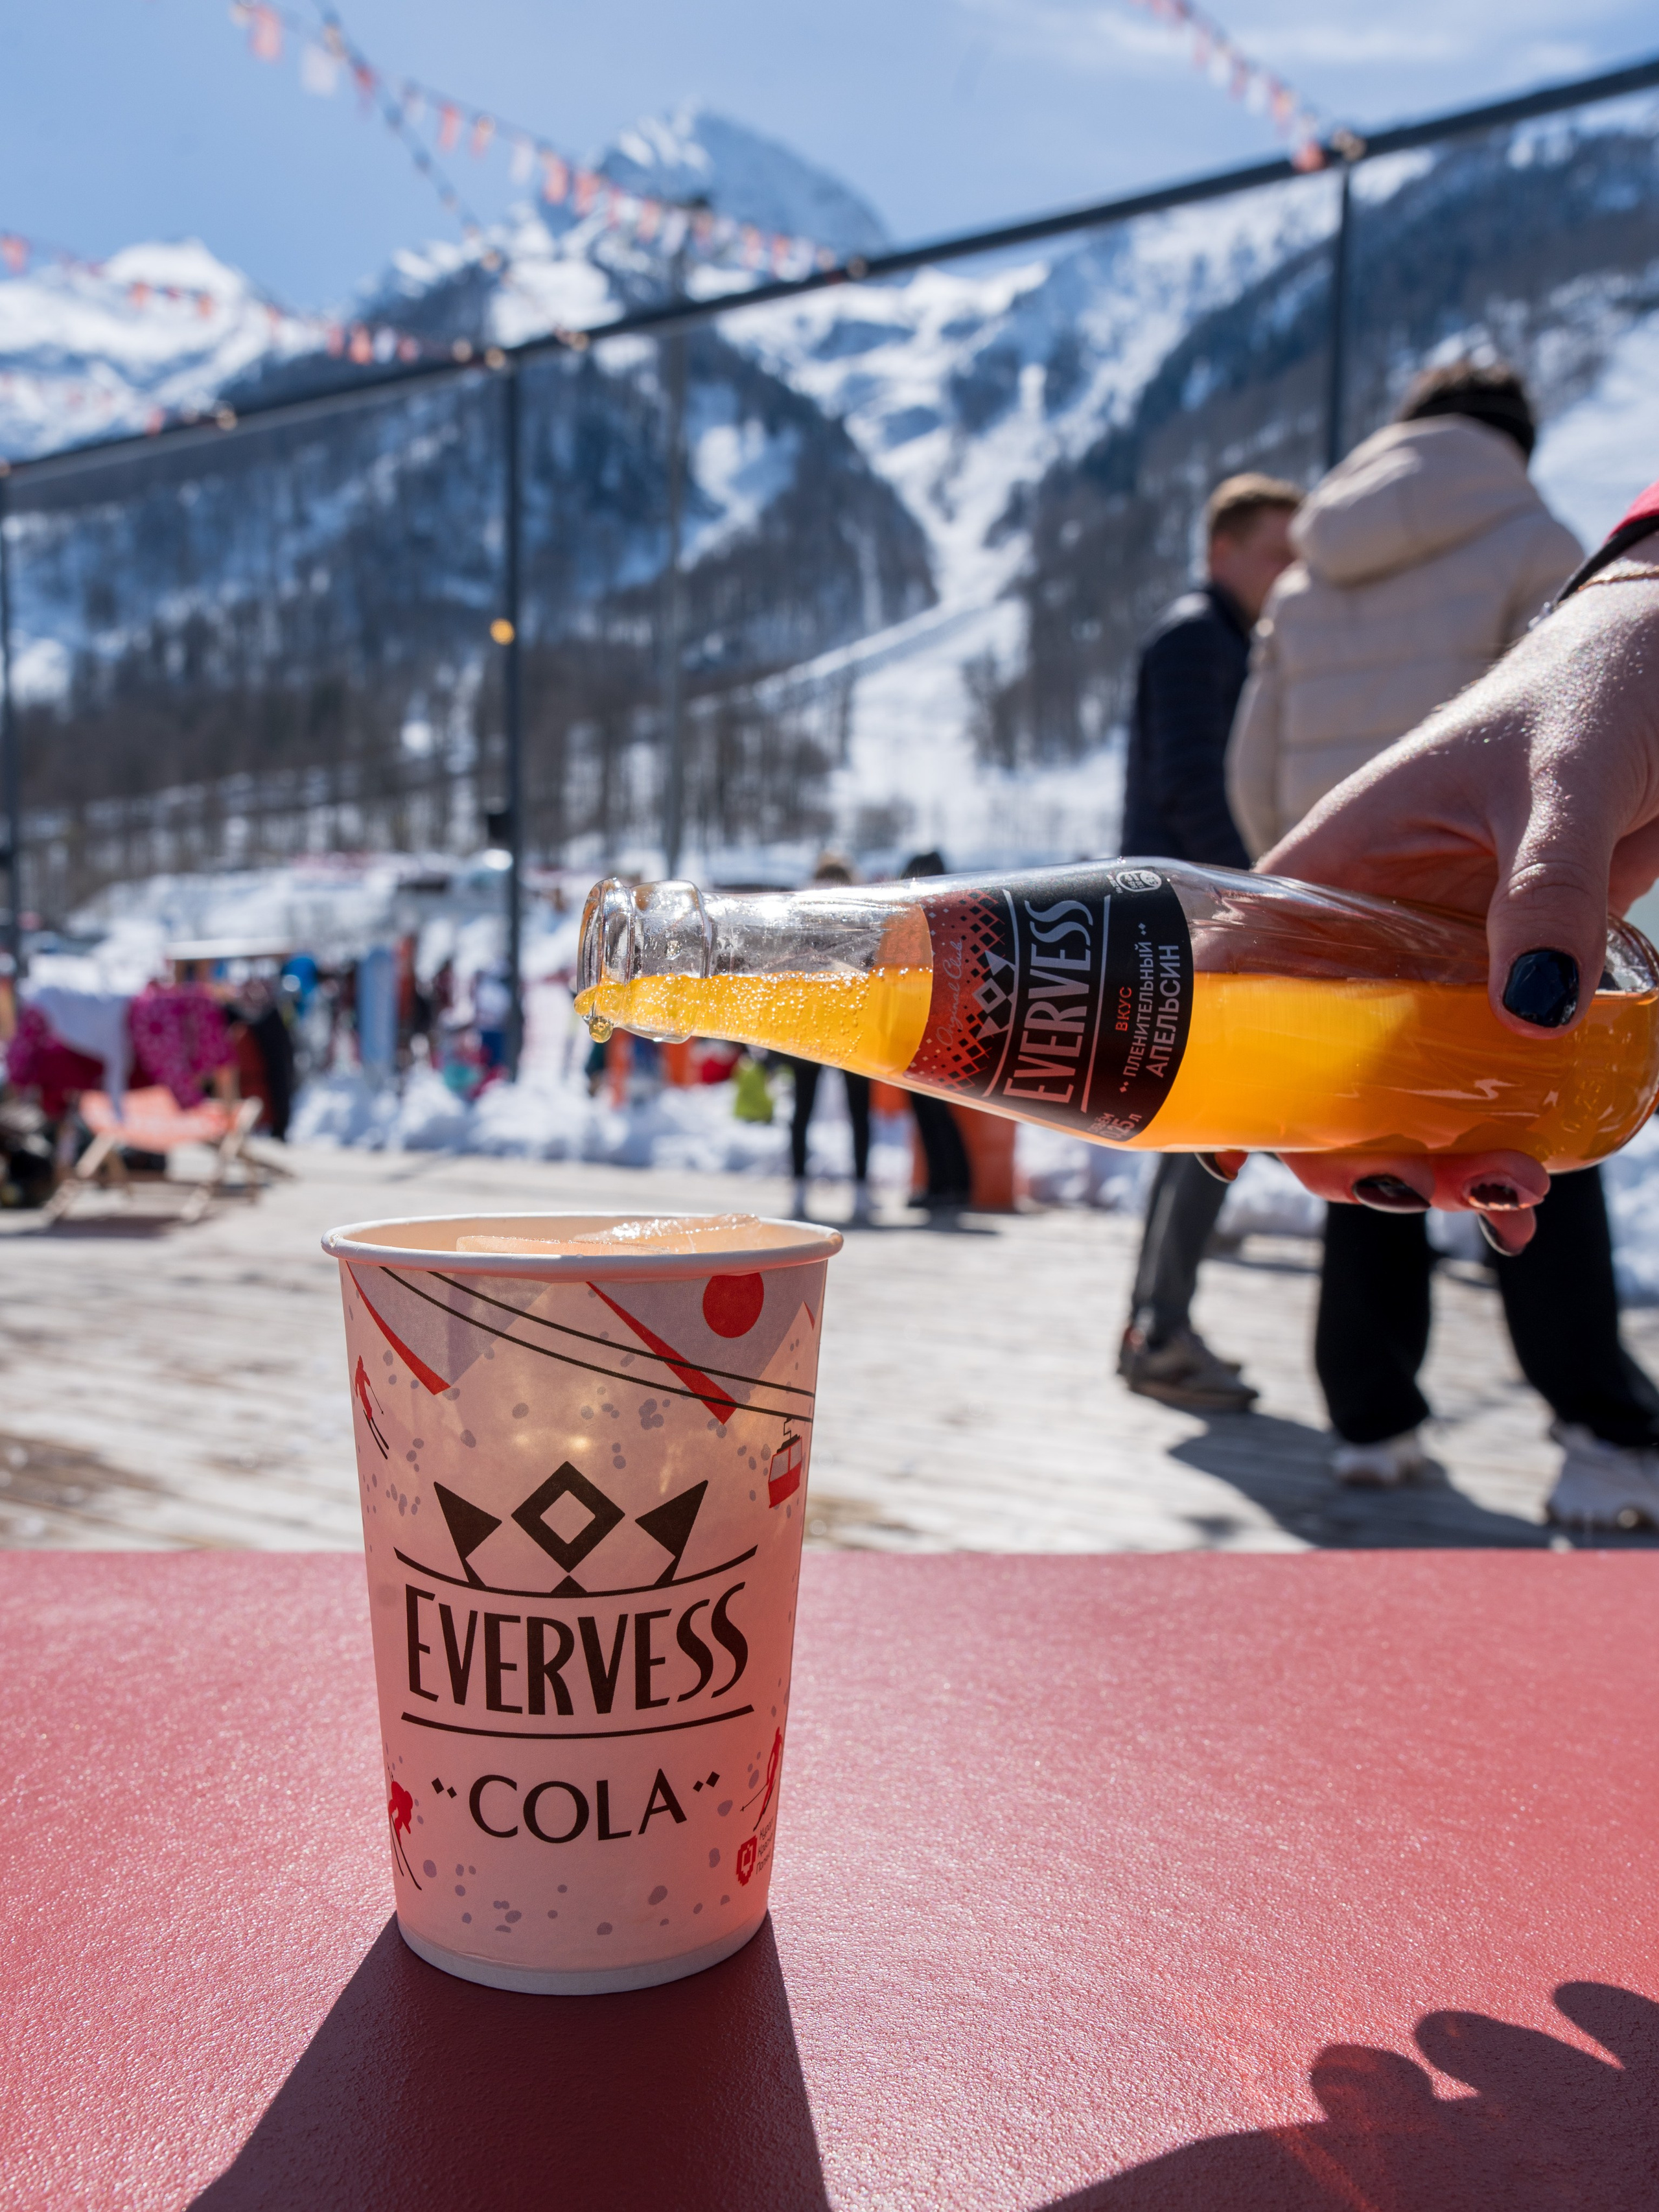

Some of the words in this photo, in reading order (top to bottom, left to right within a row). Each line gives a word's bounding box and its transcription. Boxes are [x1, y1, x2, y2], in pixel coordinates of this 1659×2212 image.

[943, 938, 962, 979] Club
[1003, 900, 1093, 1104] EVERVESS
[1115, 986, 1132, 1032] ВКУС
[1122, 941, 1154, 1077] ПЛЕНИТЕЛЬНЫЙ
[1145, 944, 1181, 1078] АПЕЛЬСИН
[936, 983, 963, 1045] Original
[406, 1581, 748, 1716] EVERVESS
[469, 1768, 687, 1844] COLA
